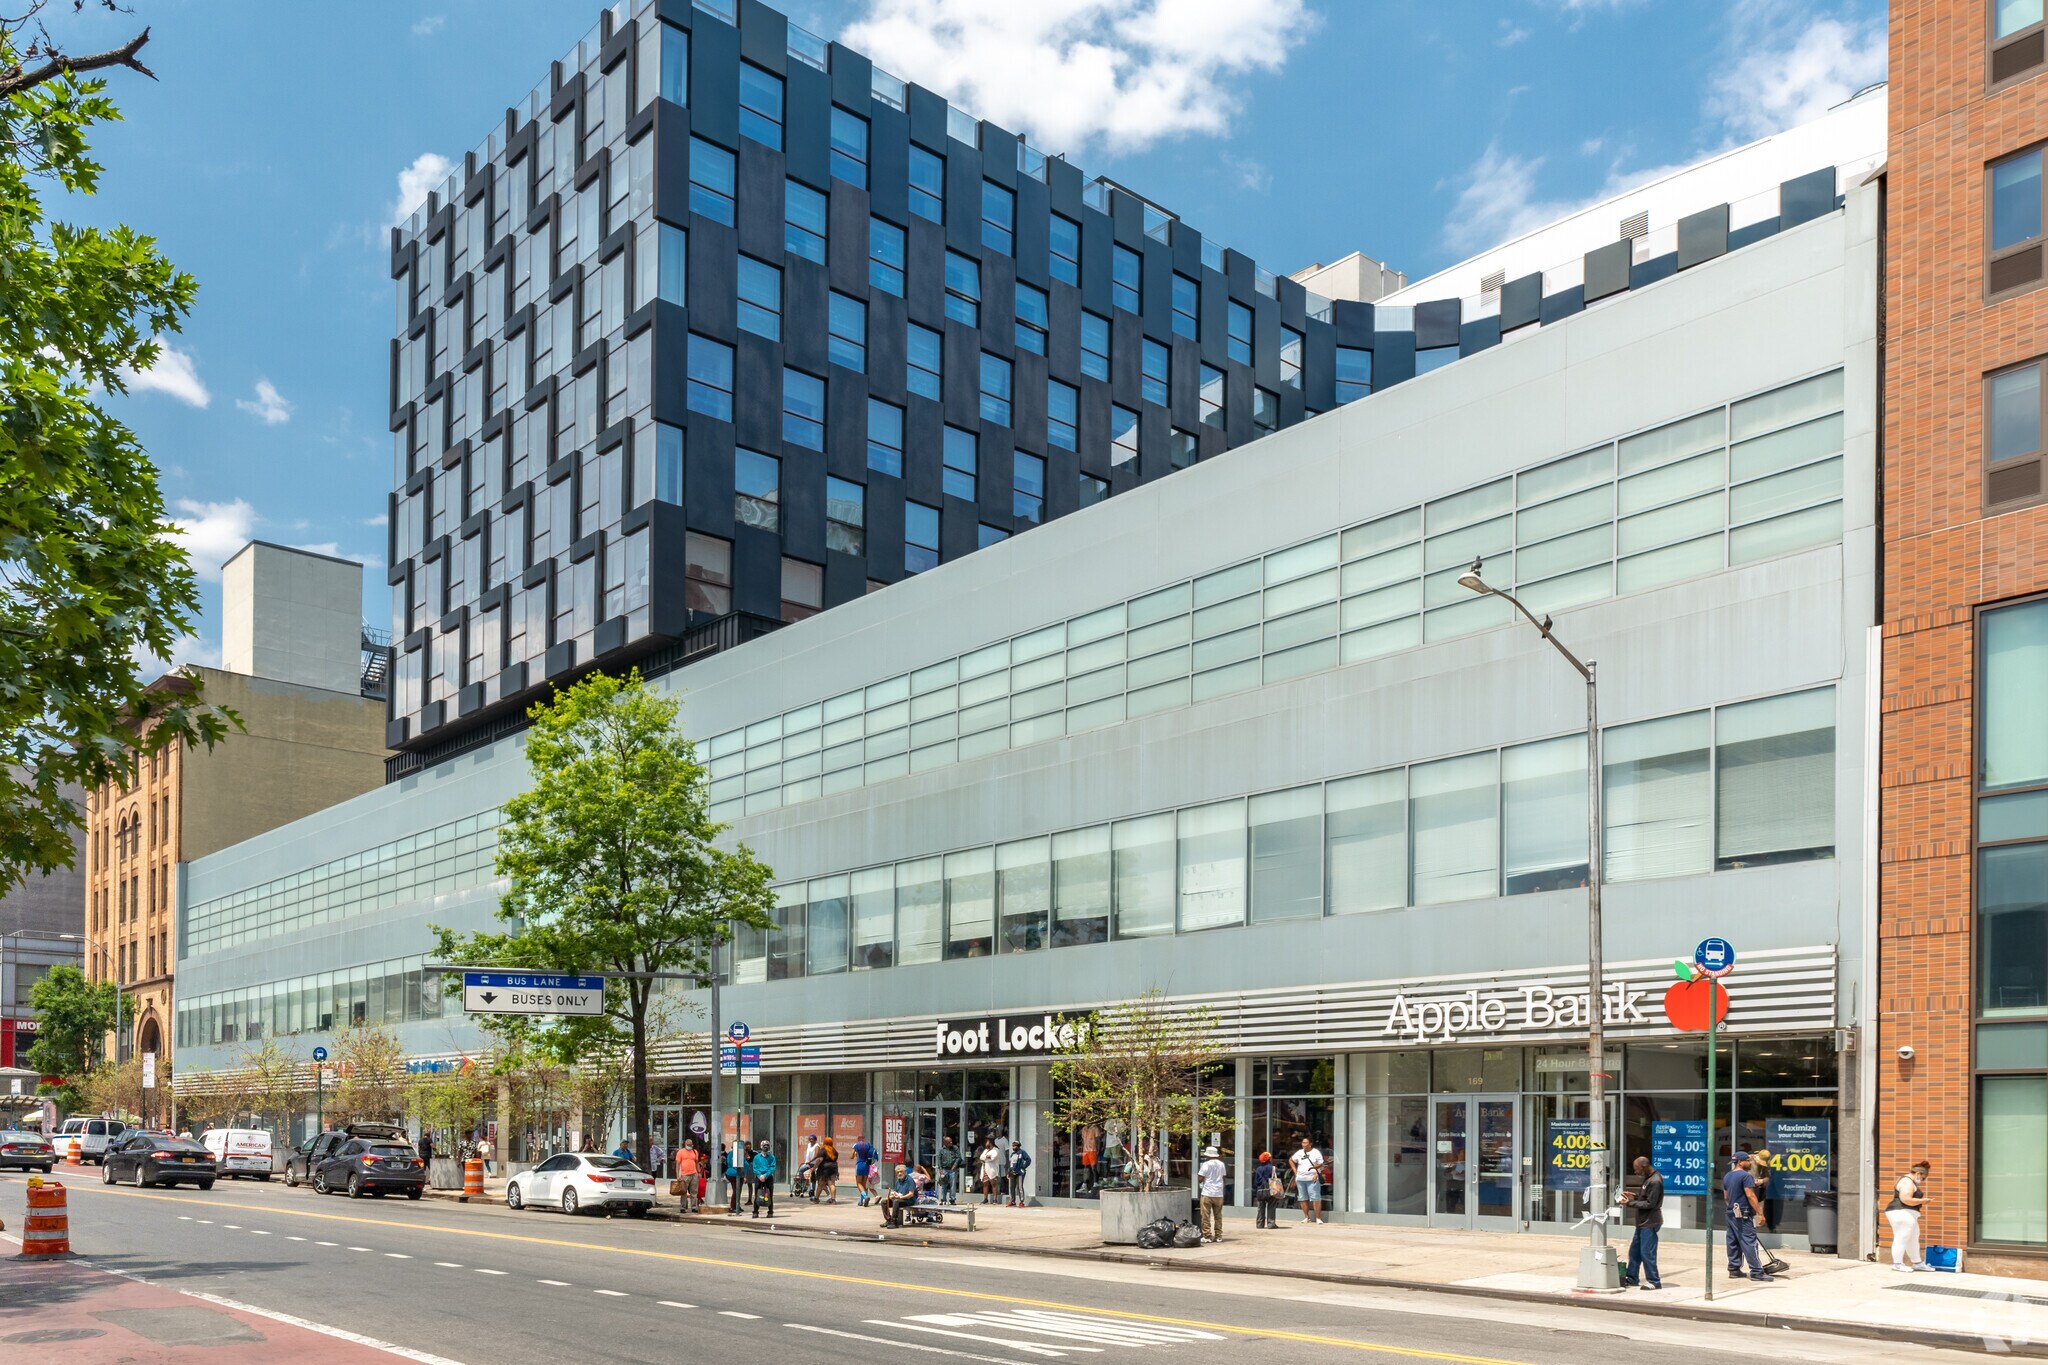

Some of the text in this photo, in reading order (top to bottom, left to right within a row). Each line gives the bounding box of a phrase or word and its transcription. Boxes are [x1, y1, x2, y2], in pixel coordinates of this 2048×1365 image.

[507, 977, 561, 986] BUS LANE
[512, 995, 588, 1006] BUSES ONLY
[1382, 981, 1649, 1043] Apple Bank
[936, 1015, 1090, 1054] Foot Locker
[1536, 1058, 1620, 1070] 24 Hour Baing
[1468, 1077, 1483, 1085] 169
[885, 1119, 902, 1132] BIG
[885, 1133, 902, 1143] NIKE
[885, 1143, 902, 1153] SALE
[1769, 1153, 1827, 1172] 4.00%
